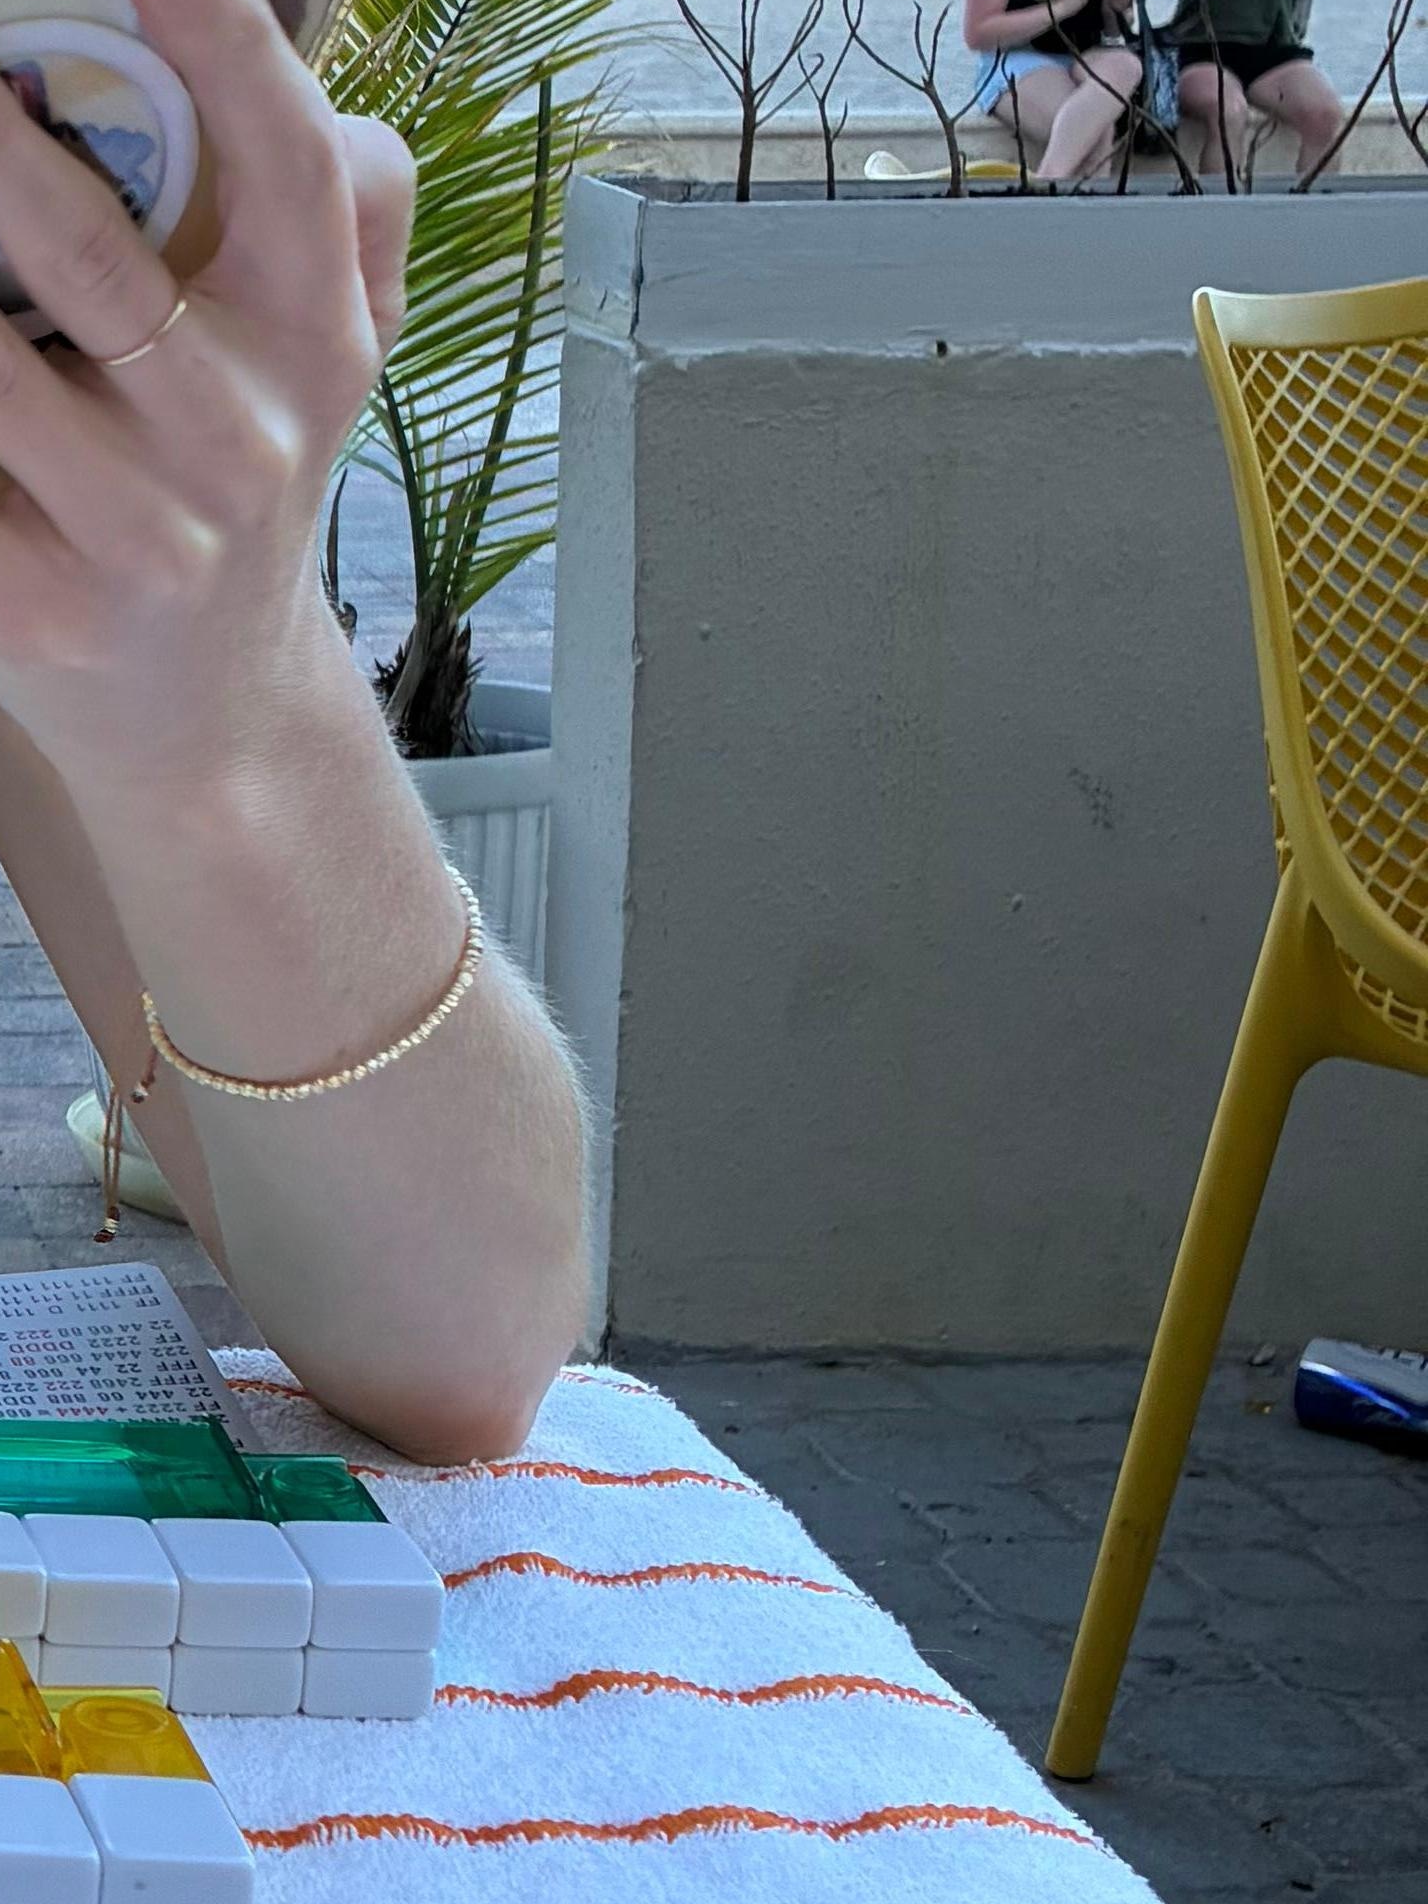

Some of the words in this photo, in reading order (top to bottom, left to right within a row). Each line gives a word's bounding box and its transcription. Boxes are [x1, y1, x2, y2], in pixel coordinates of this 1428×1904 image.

[14, 1330, 51, 1339] 222
[9, 1341, 74, 1353] DDDD
[87, 1335, 140, 1348] 2222
[90, 1349, 141, 1360] 4444
[150, 1345, 189, 1356] 222
[156, 1359, 196, 1372] FFF
[44, 1380, 83, 1390] 222
[149, 1374, 204, 1385] FFFF
[0, 1383, 38, 1392] 222
[135, 1390, 174, 1400] 444
[56, 1406, 109, 1416] 4444
